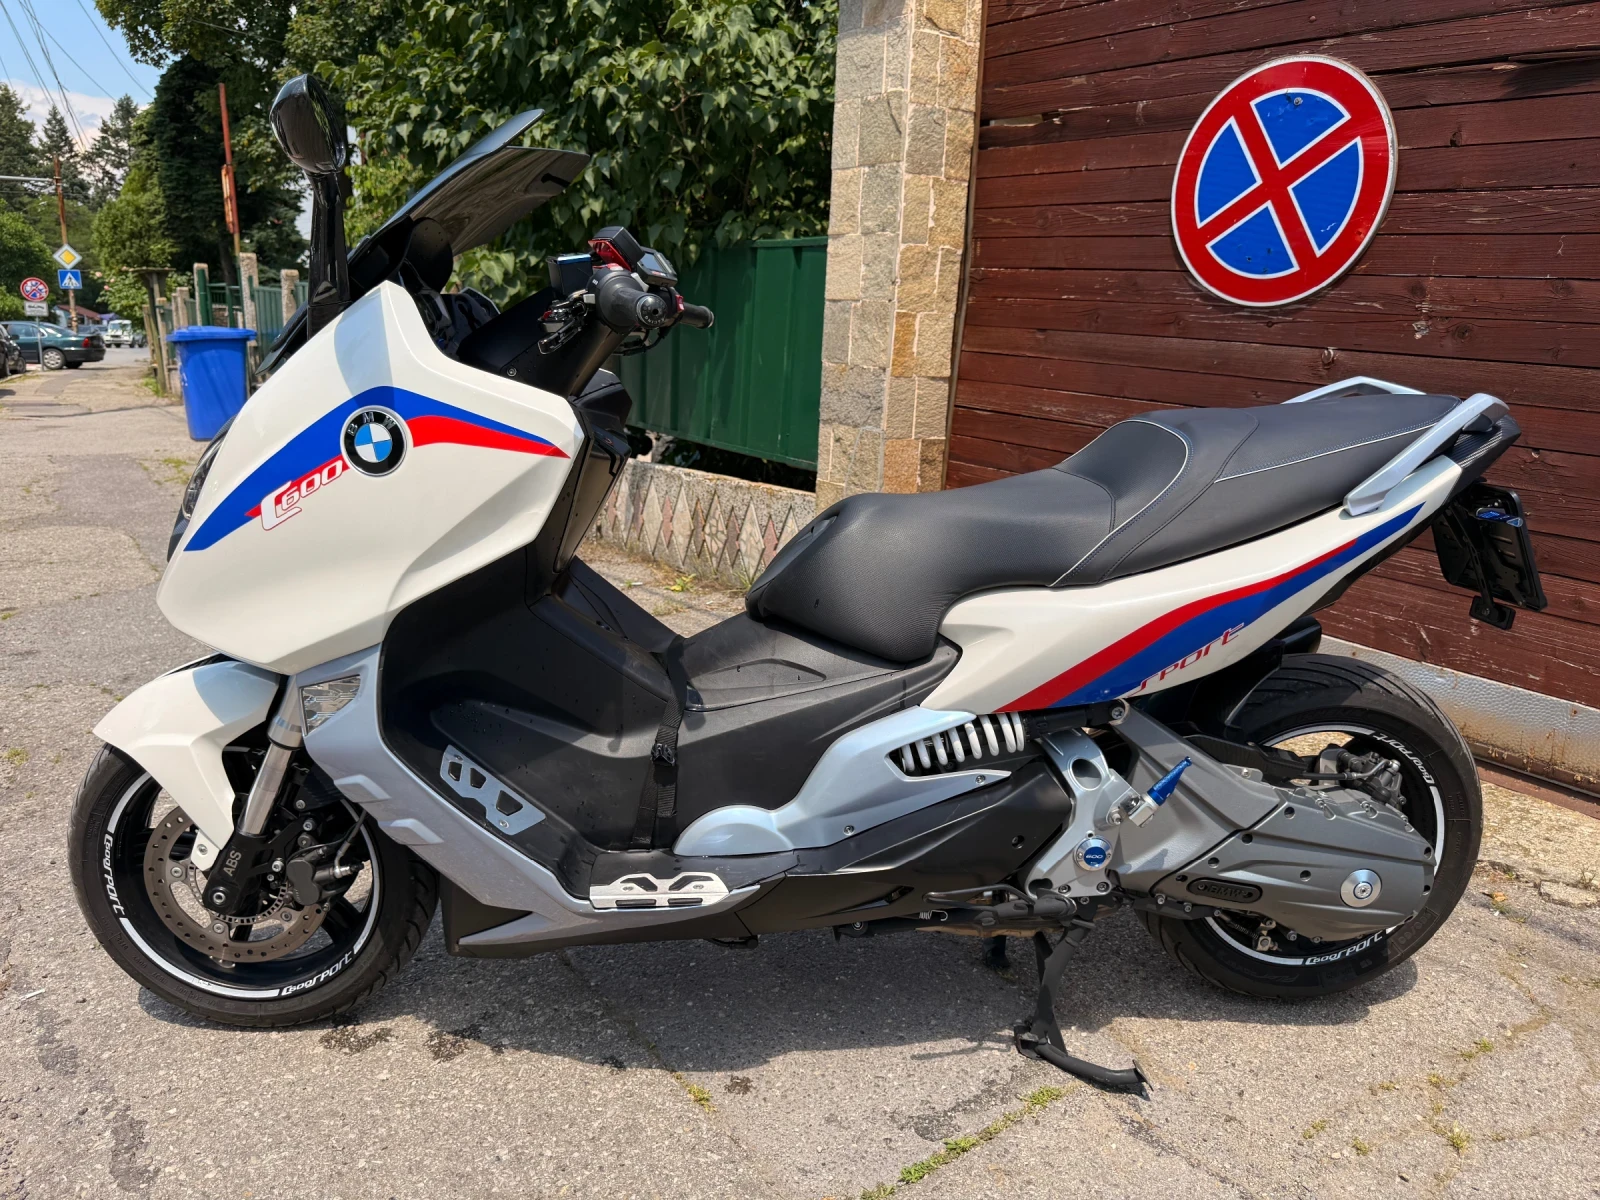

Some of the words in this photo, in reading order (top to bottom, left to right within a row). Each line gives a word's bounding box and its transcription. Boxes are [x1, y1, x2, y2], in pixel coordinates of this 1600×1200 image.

[347, 411, 397, 437] BMW
[260, 458, 344, 531] C600
[223, 850, 242, 877] ABS
[1207, 885, 1242, 898] BMW
